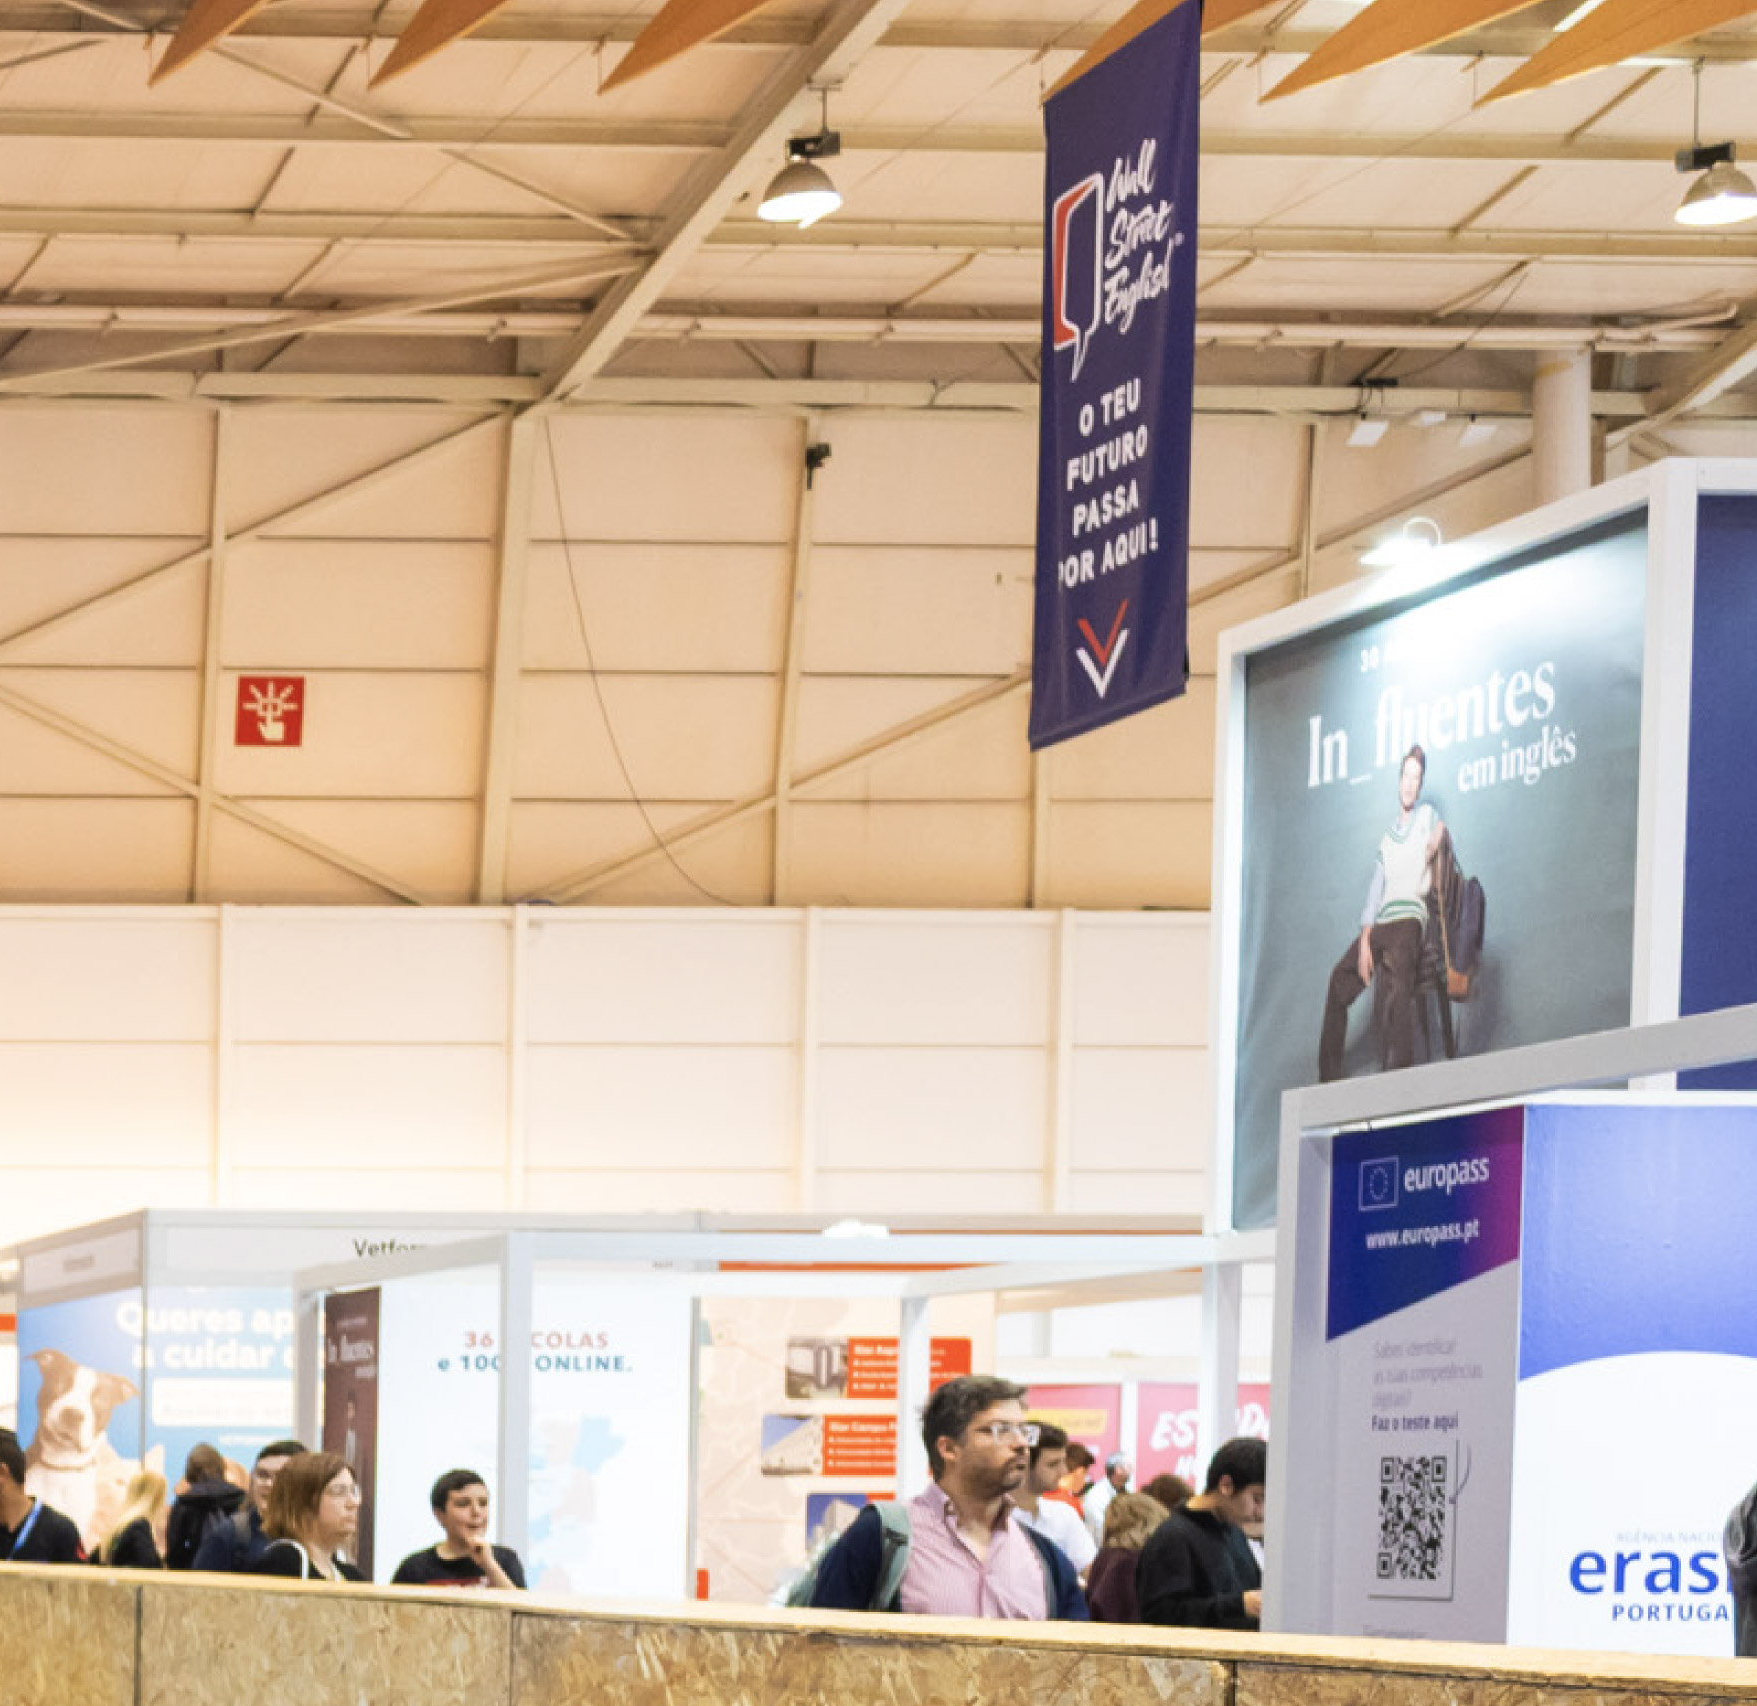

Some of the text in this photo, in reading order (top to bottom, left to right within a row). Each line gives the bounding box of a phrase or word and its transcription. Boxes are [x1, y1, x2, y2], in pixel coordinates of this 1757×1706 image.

[1106, 138, 1157, 213] Wall
[1104, 200, 1174, 271] Street
[1103, 238, 1173, 334] English
[1079, 377, 1141, 437] O TEU
[1066, 424, 1148, 492] FUTURO
[1072, 478, 1139, 538] PASSA
[1458, 722, 1577, 793] em inglês
[1405, 1154, 1490, 1195] europass
[1366, 1217, 1480, 1250] www.europass.pt
[116, 1301, 245, 1337] Queres
[465, 1331, 609, 1349] 36 COLAS
[132, 1345, 154, 1368] a
[163, 1338, 275, 1369] cuidar
[438, 1355, 633, 1373] e 100 ONLINE.
[1372, 1411, 1458, 1433] Faz o teste aqui
[1569, 1550, 1733, 1595] eras
[1612, 1604, 1730, 1622] PORTUGA
